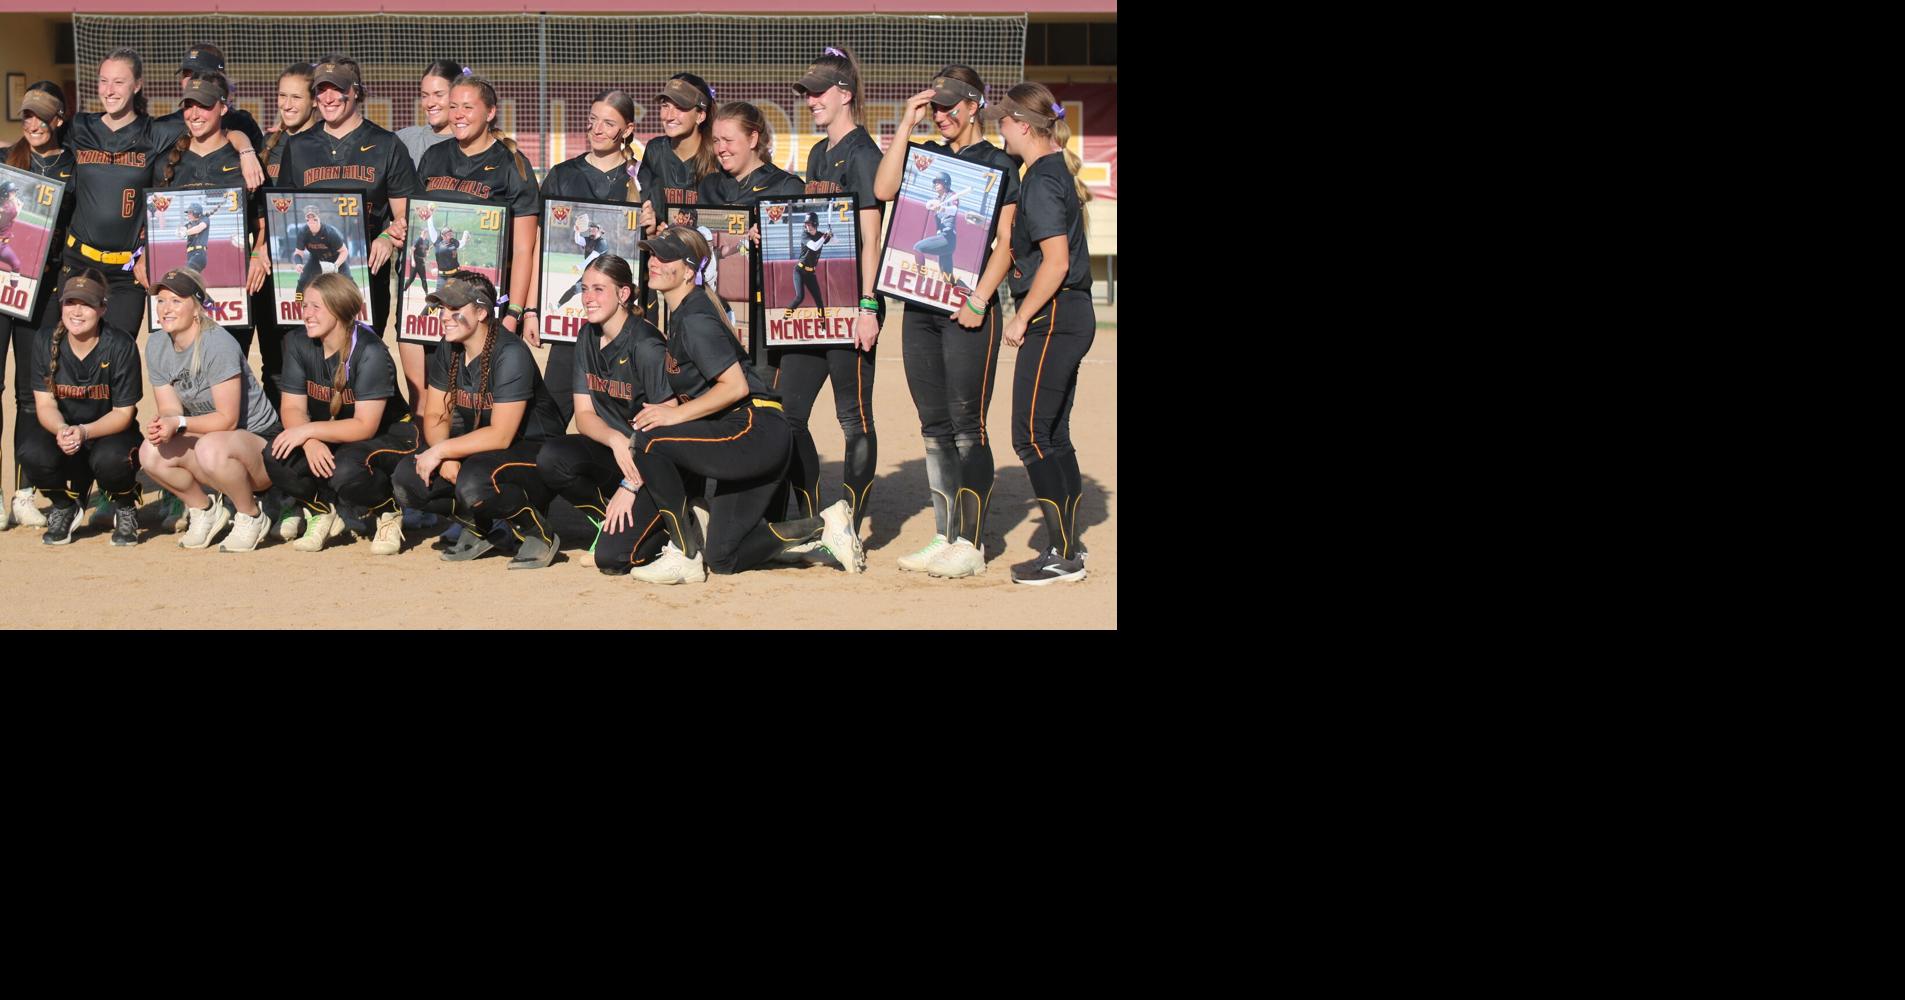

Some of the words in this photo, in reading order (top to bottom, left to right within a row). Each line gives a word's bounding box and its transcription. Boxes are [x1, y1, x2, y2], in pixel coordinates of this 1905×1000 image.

[303, 166, 340, 187] INDIAN
[342, 164, 376, 183] HILLS
[121, 188, 136, 219] 6
[883, 265, 970, 308] LEWIS
